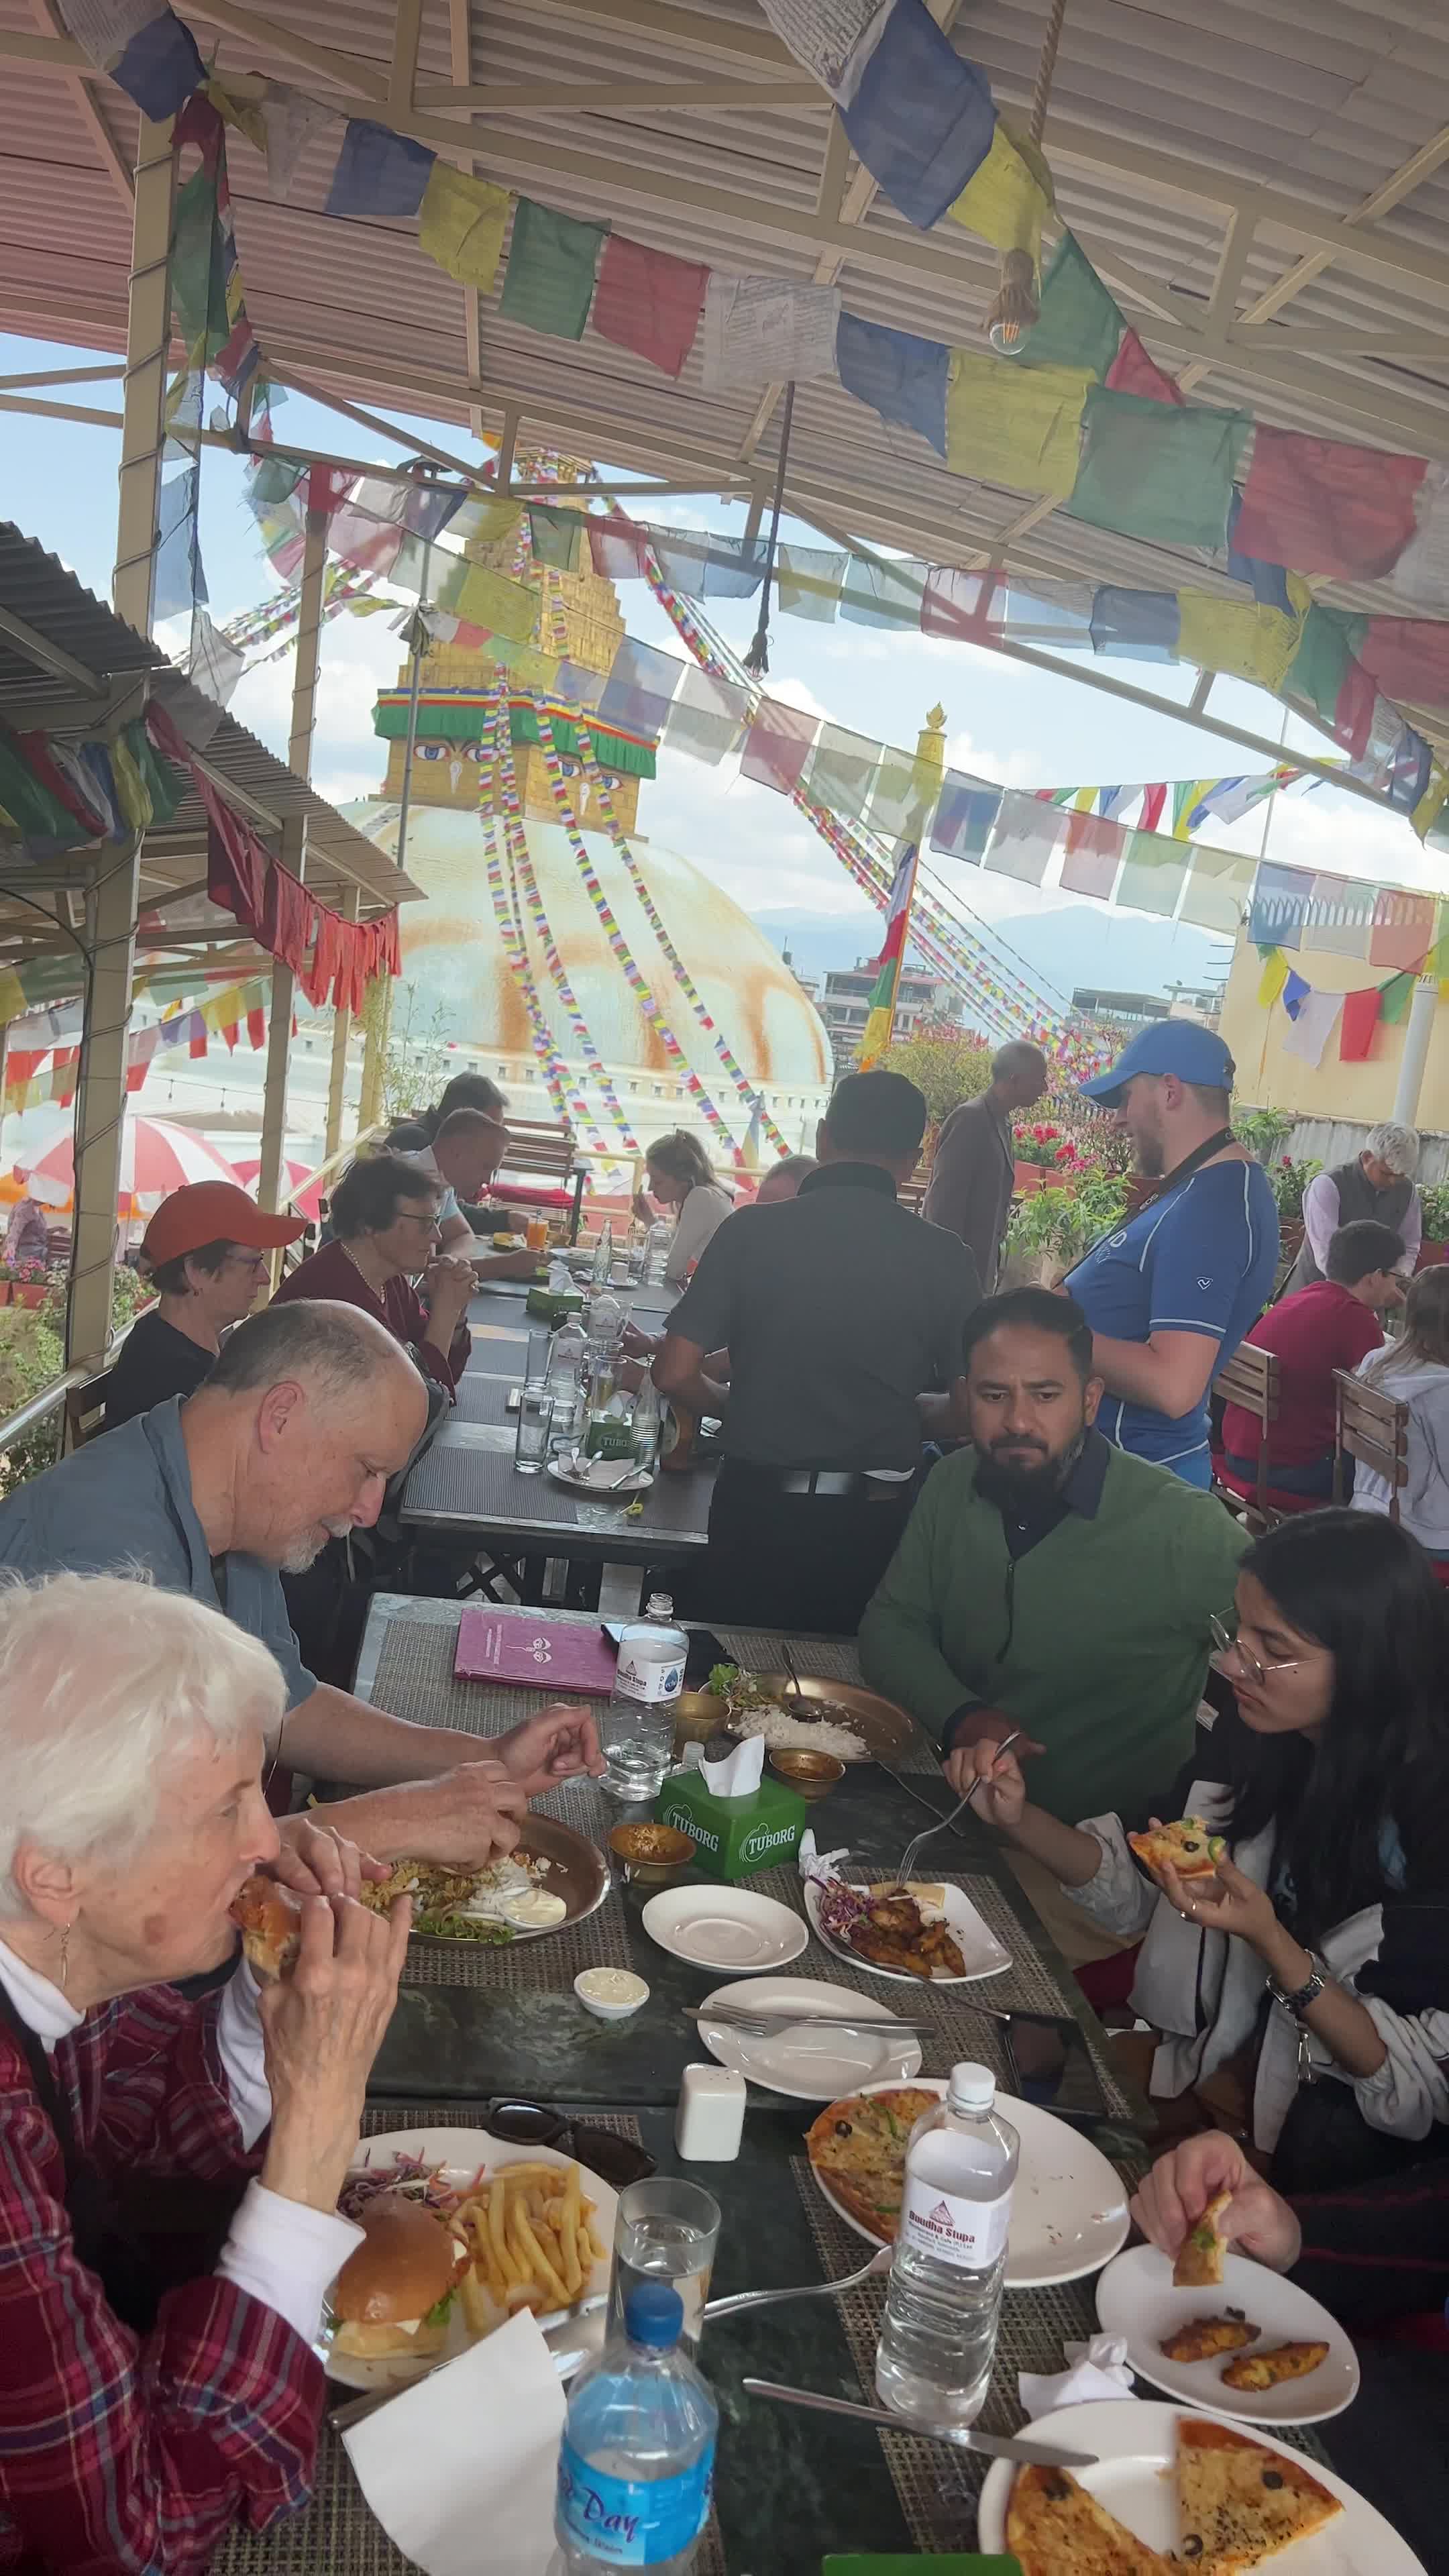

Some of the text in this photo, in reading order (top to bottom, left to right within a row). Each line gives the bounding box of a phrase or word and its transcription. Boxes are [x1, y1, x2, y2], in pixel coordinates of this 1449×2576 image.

[601, 1437, 628, 1448] TUBO
[672, 1811, 719, 1852] TUBORG
[748, 1824, 796, 1855] TUBORG
[909, 2210, 943, 2235] Boudha
[945, 2227, 975, 2243] Stupa
[580, 2485, 639, 2544] Day
